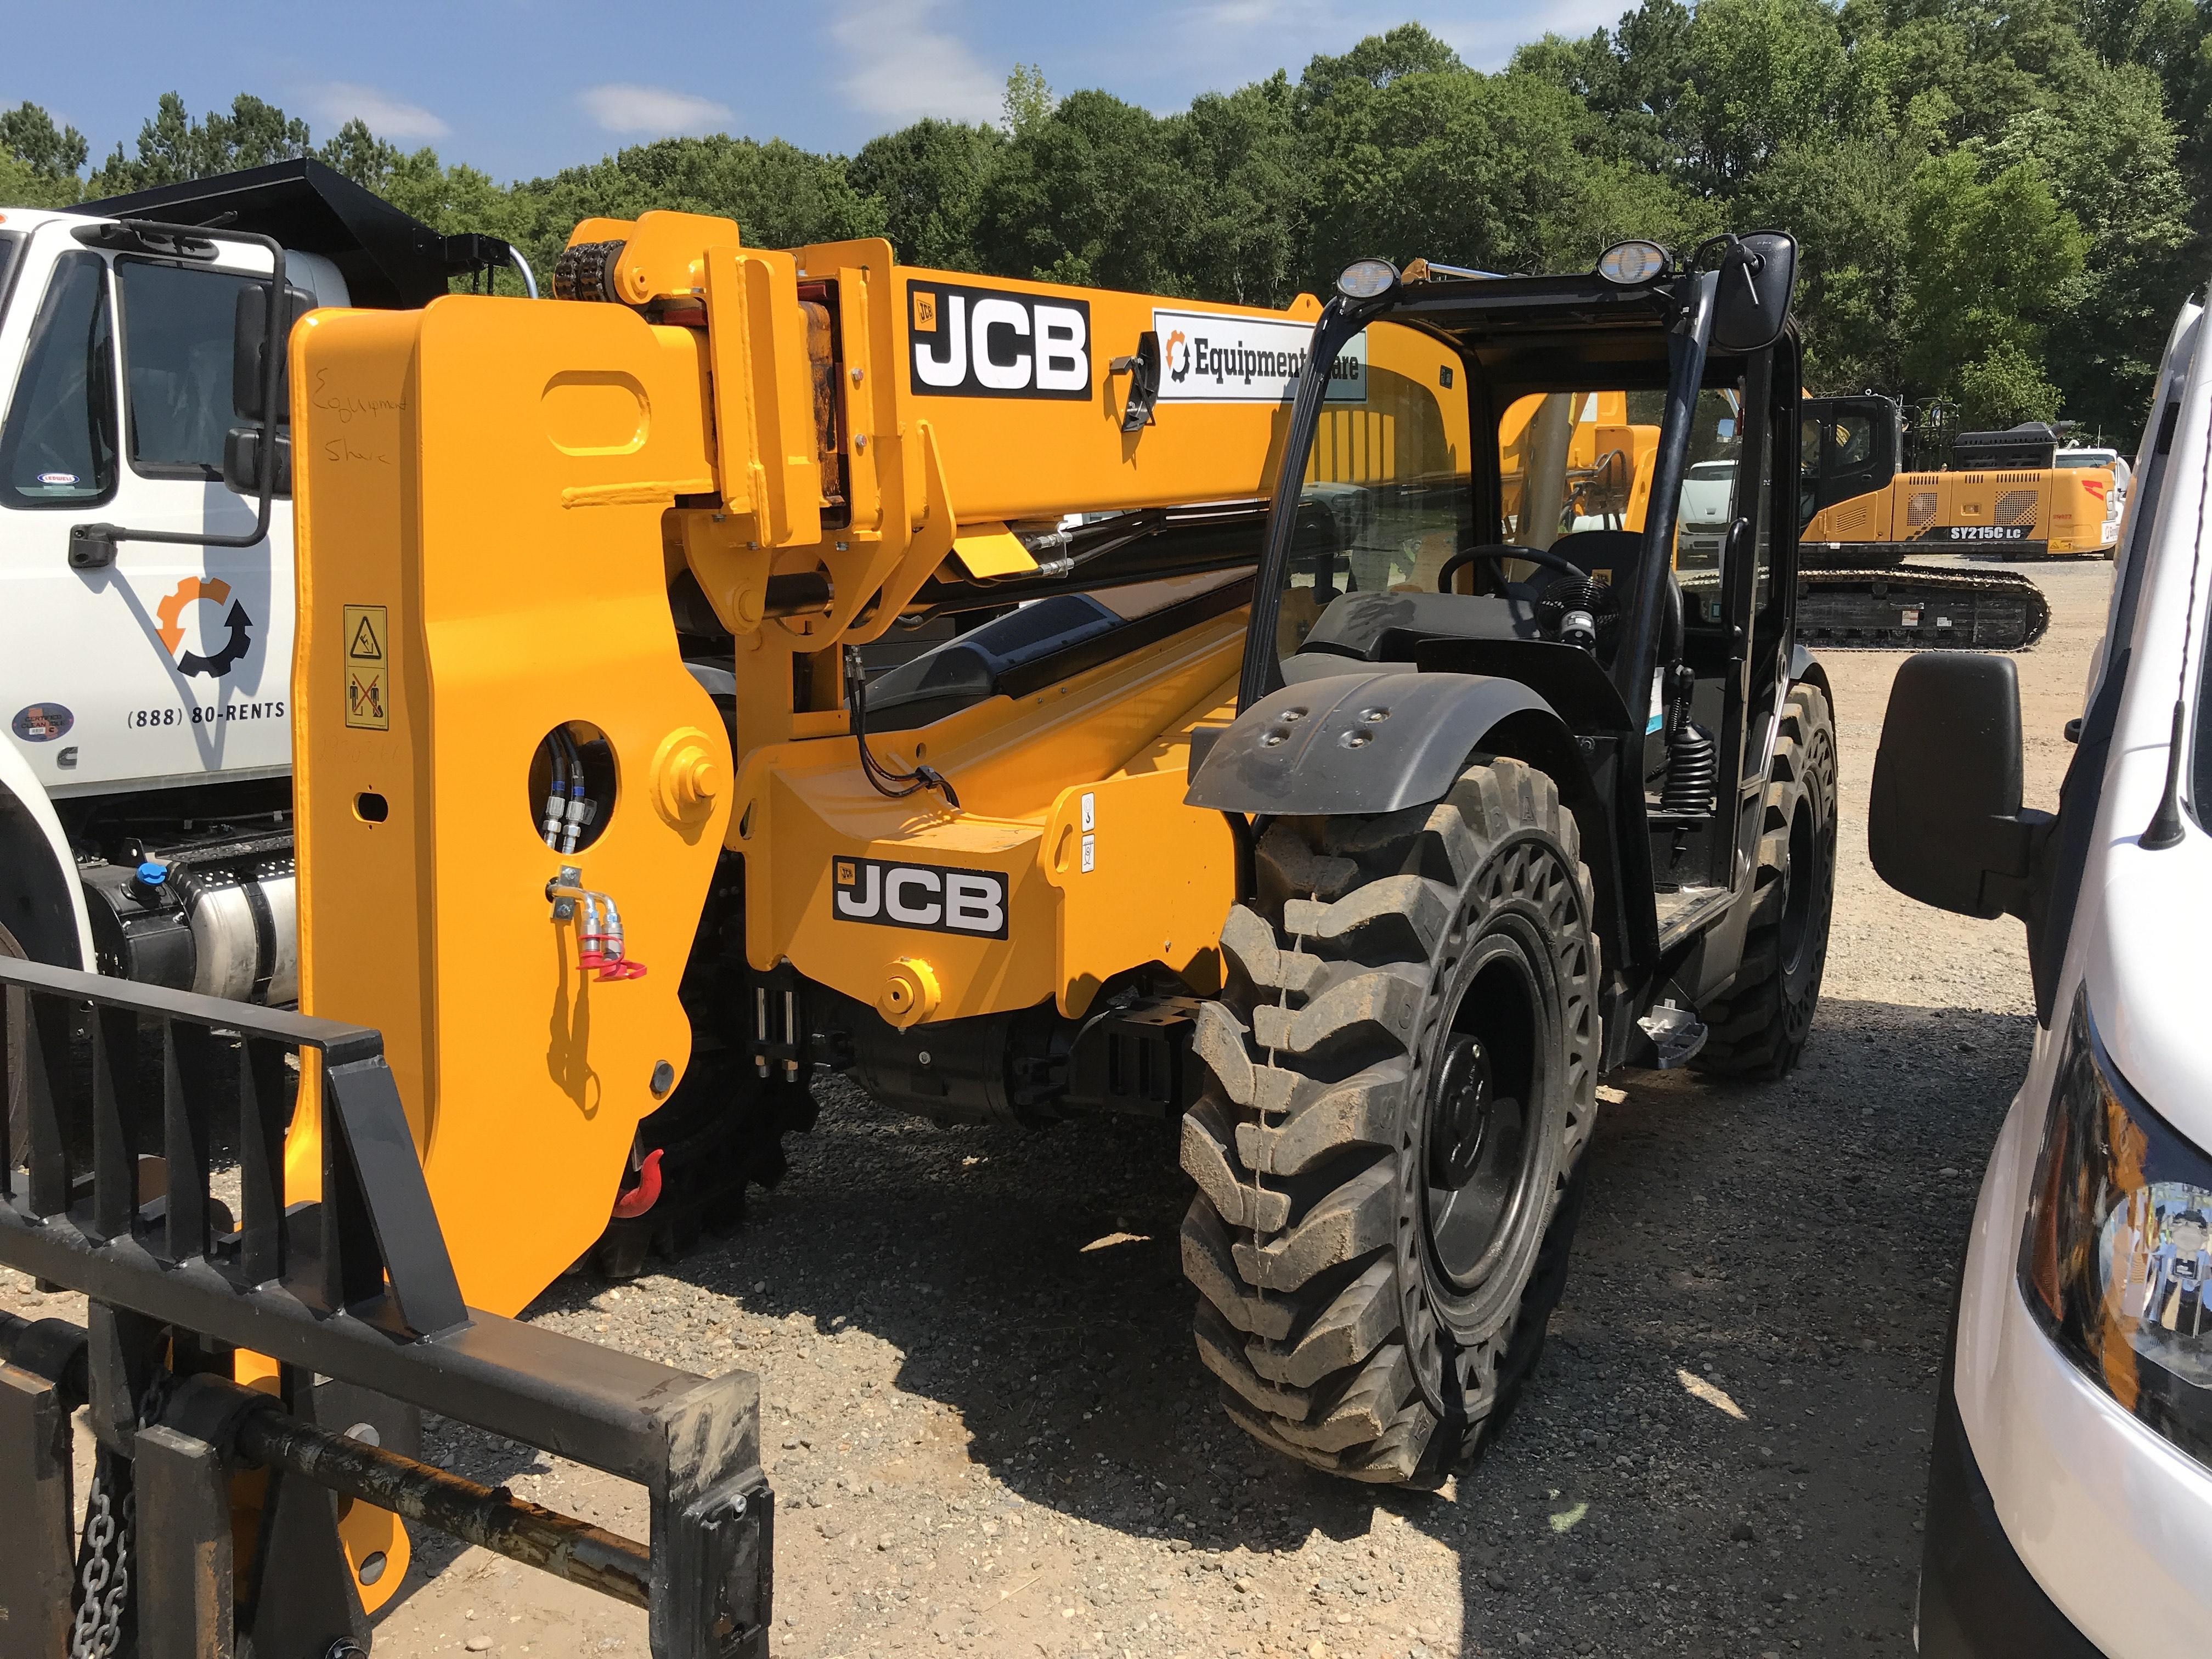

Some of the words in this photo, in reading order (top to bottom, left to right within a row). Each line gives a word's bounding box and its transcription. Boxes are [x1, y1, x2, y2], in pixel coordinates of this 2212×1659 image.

[919, 302, 933, 321] JCB
[915, 295, 1088, 391] JCB
[1194, 337, 1359, 385] Equipmentare
[1951, 527, 2004, 539] SY215C
[2006, 528, 2021, 539] LC
[128, 708, 182, 729] (888)
[192, 702, 285, 724] 80-RENTS
[842, 868, 853, 879] JCB
[838, 865, 1003, 932] JCB
